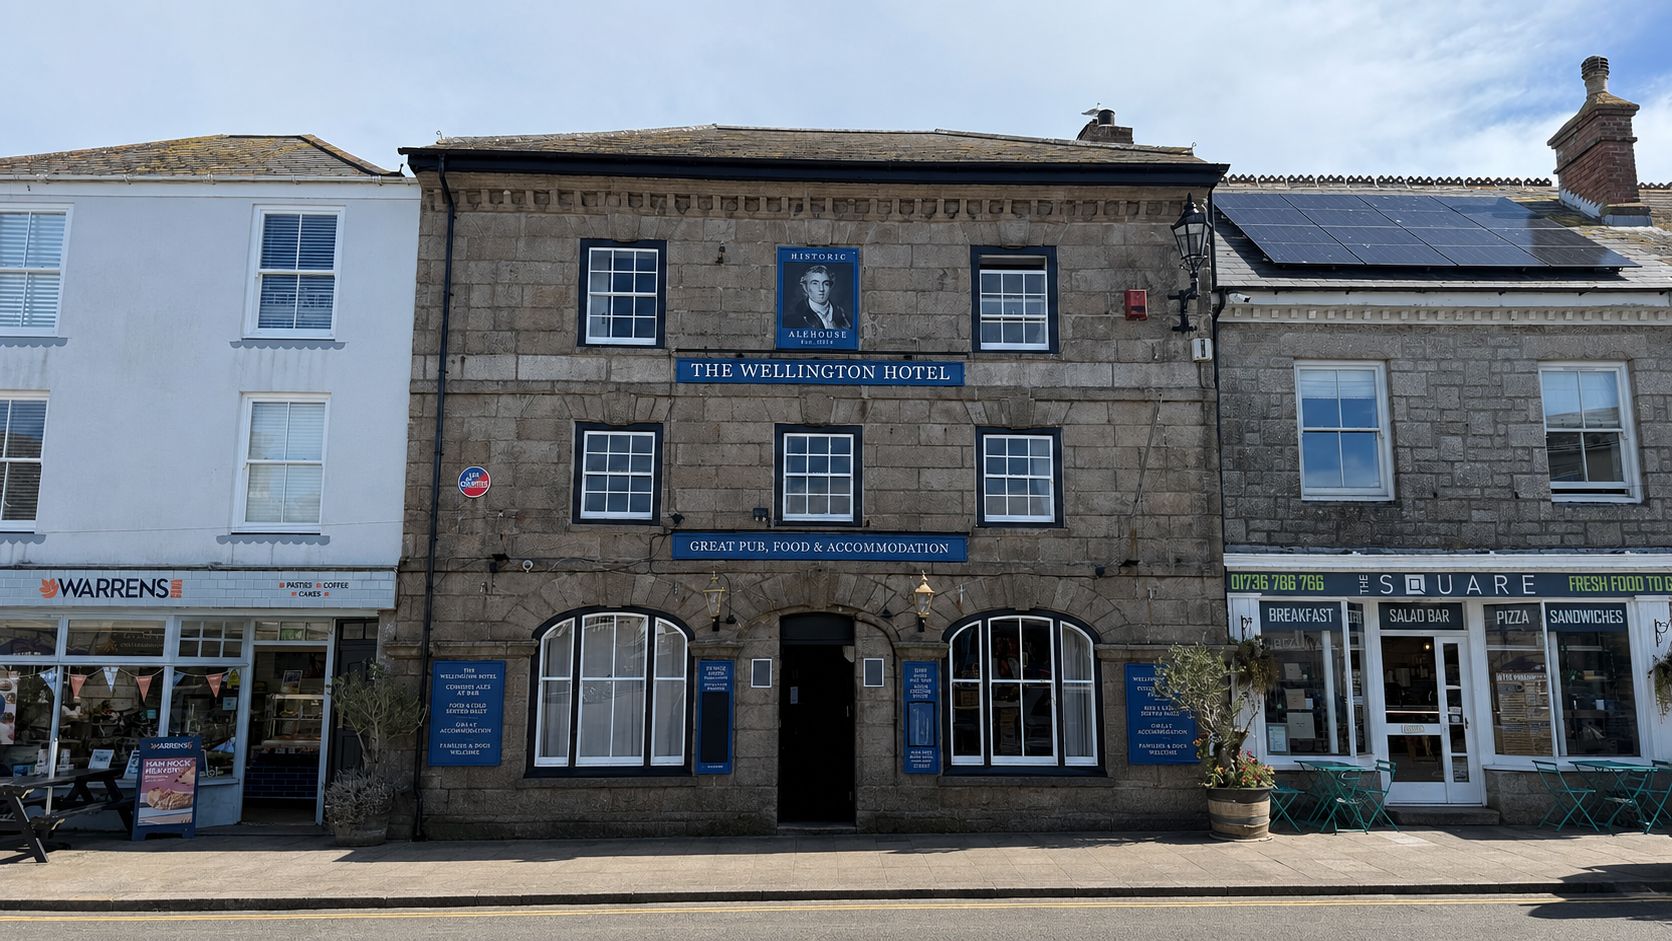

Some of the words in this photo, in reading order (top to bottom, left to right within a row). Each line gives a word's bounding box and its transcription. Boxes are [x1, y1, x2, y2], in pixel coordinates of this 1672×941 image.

[788, 331, 847, 339] ALEHOUSE
[691, 363, 733, 377] THE
[740, 363, 876, 379] WELLINGTON
[883, 365, 951, 380] HOTEL
[690, 541, 735, 552] GREAT
[740, 541, 769, 553] PUB,
[773, 542, 810, 552] FOOD
[813, 542, 823, 552] &
[827, 542, 949, 554] ACCOMMODATION
[58, 578, 169, 599] WARRENS
[1231, 574, 1269, 590] 01736
[1299, 574, 1324, 591] 766
[1359, 574, 1369, 594] THE
[1568, 575, 1608, 592] FRESH
[1611, 575, 1644, 592] FOOD
[1646, 576, 1663, 592] TO
[1268, 608, 1333, 623] BREAKFAST
[1389, 608, 1424, 623] SALAD
[1427, 608, 1450, 623] BAR
[1496, 610, 1530, 624] PIZZA
[1550, 609, 1623, 624] SANDWICHES
